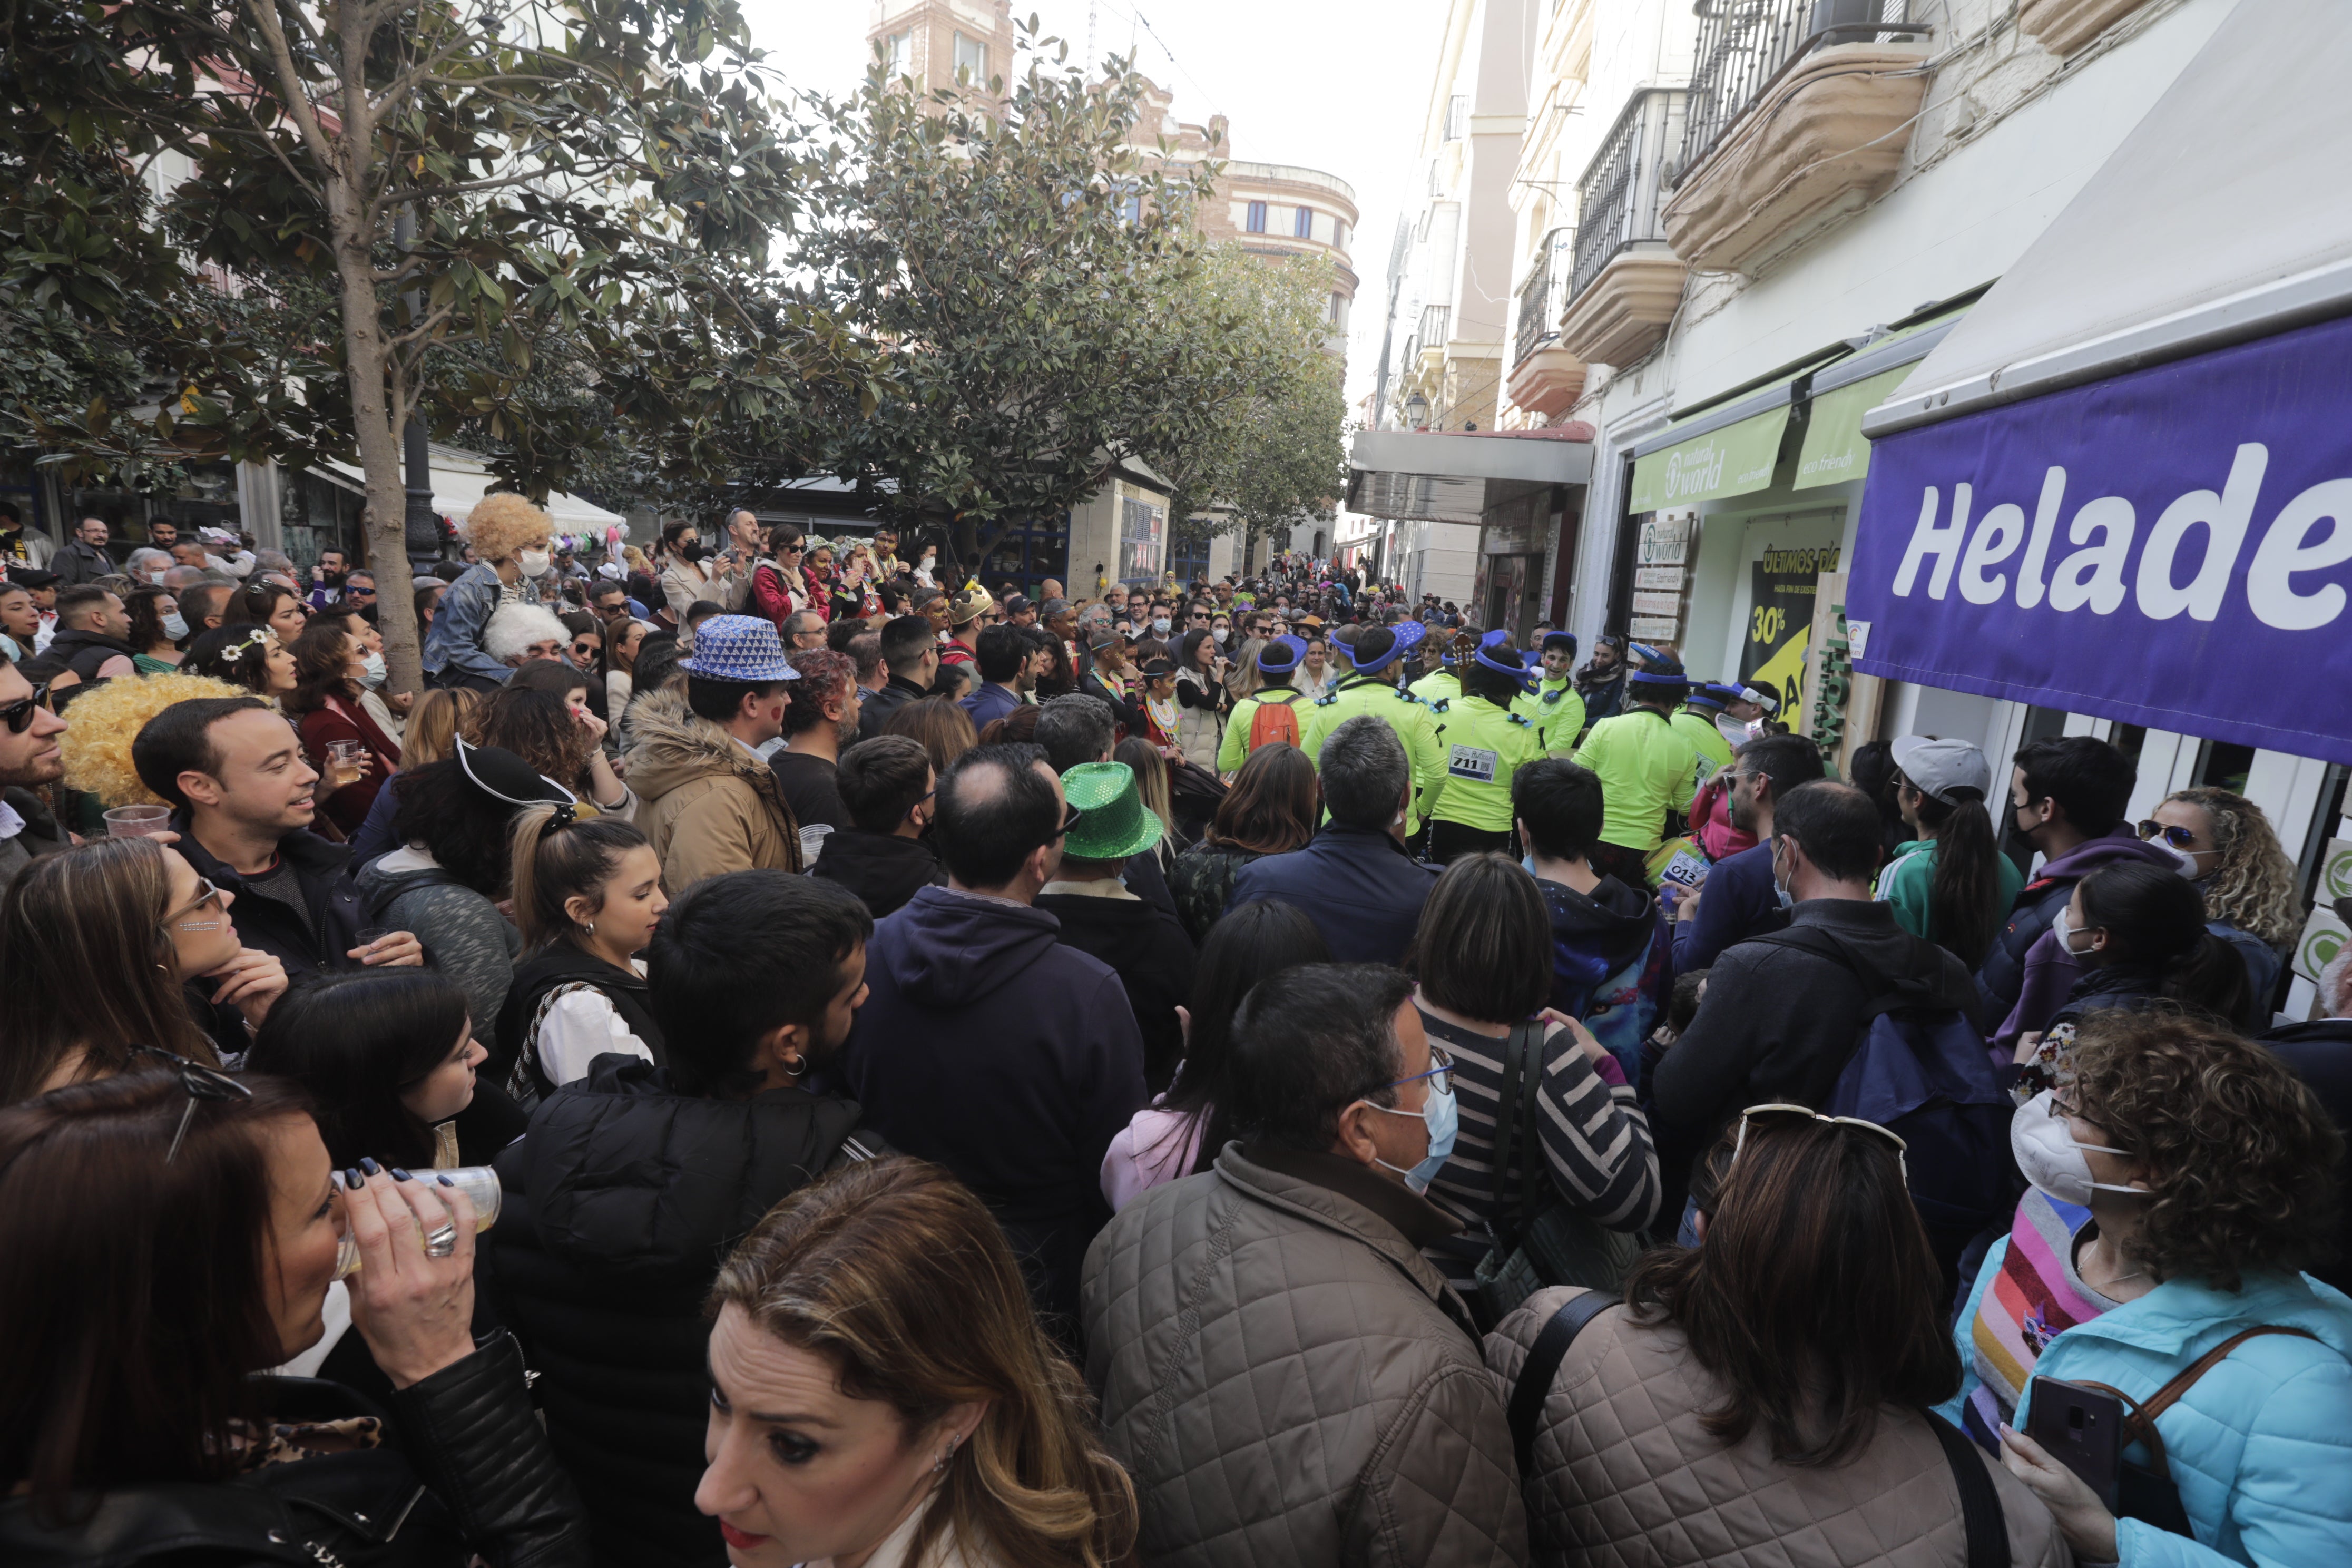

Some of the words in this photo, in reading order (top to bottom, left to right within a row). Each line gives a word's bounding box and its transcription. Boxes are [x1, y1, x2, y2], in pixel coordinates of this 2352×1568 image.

[1684, 439, 1713, 467] natural
[1681, 448, 1726, 496] world
[1802, 460, 1817, 474] eco
[1657, 524, 1675, 540] natural
[1892, 442, 2352, 631] Helade
[1655, 533, 1682, 560] world
[1763, 543, 1816, 574] ÚLTIMOS
[1774, 584, 1786, 593] HASTA
[1752, 605, 1786, 644] 30%
[1454, 757, 1477, 769] 711
[1672, 865, 1696, 884] 013
